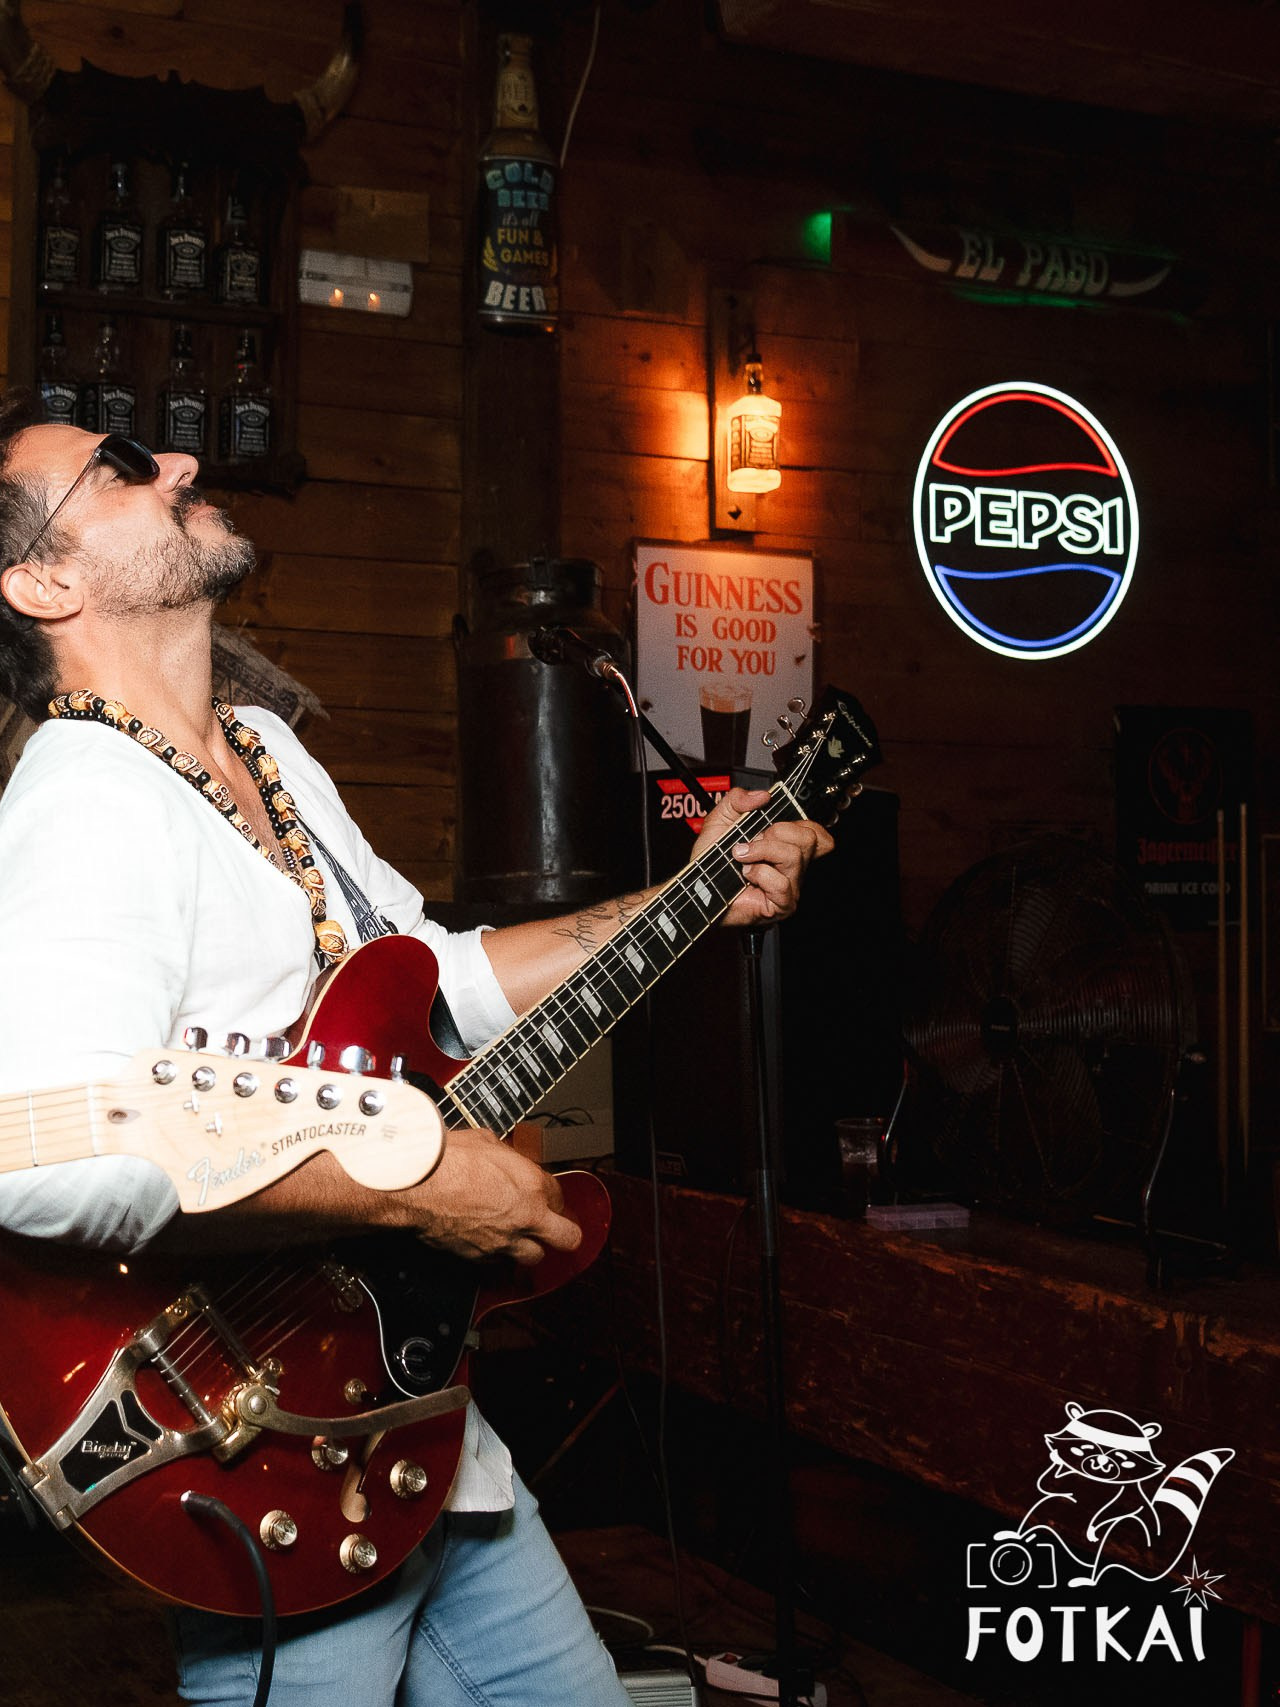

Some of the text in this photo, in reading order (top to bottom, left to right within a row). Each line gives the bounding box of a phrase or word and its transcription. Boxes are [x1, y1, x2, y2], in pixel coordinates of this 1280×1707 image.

[486, 161, 555, 193] COLD
[496, 228, 529, 246] FUN
[500, 247, 549, 268] GAMES
[954, 229, 1111, 297] EL PASO
[484, 279, 547, 313] BEER
[928, 482, 1125, 556] PEPSI
[644, 561, 804, 615] GUINNESS
[674, 612, 777, 643] IS GOOD
[676, 645, 776, 676] FOR YOU
[1144, 881, 1232, 896] DRINK ICE COD
[186, 1147, 267, 1207] Fender
[271, 1122, 367, 1156] STRATOCASTER
